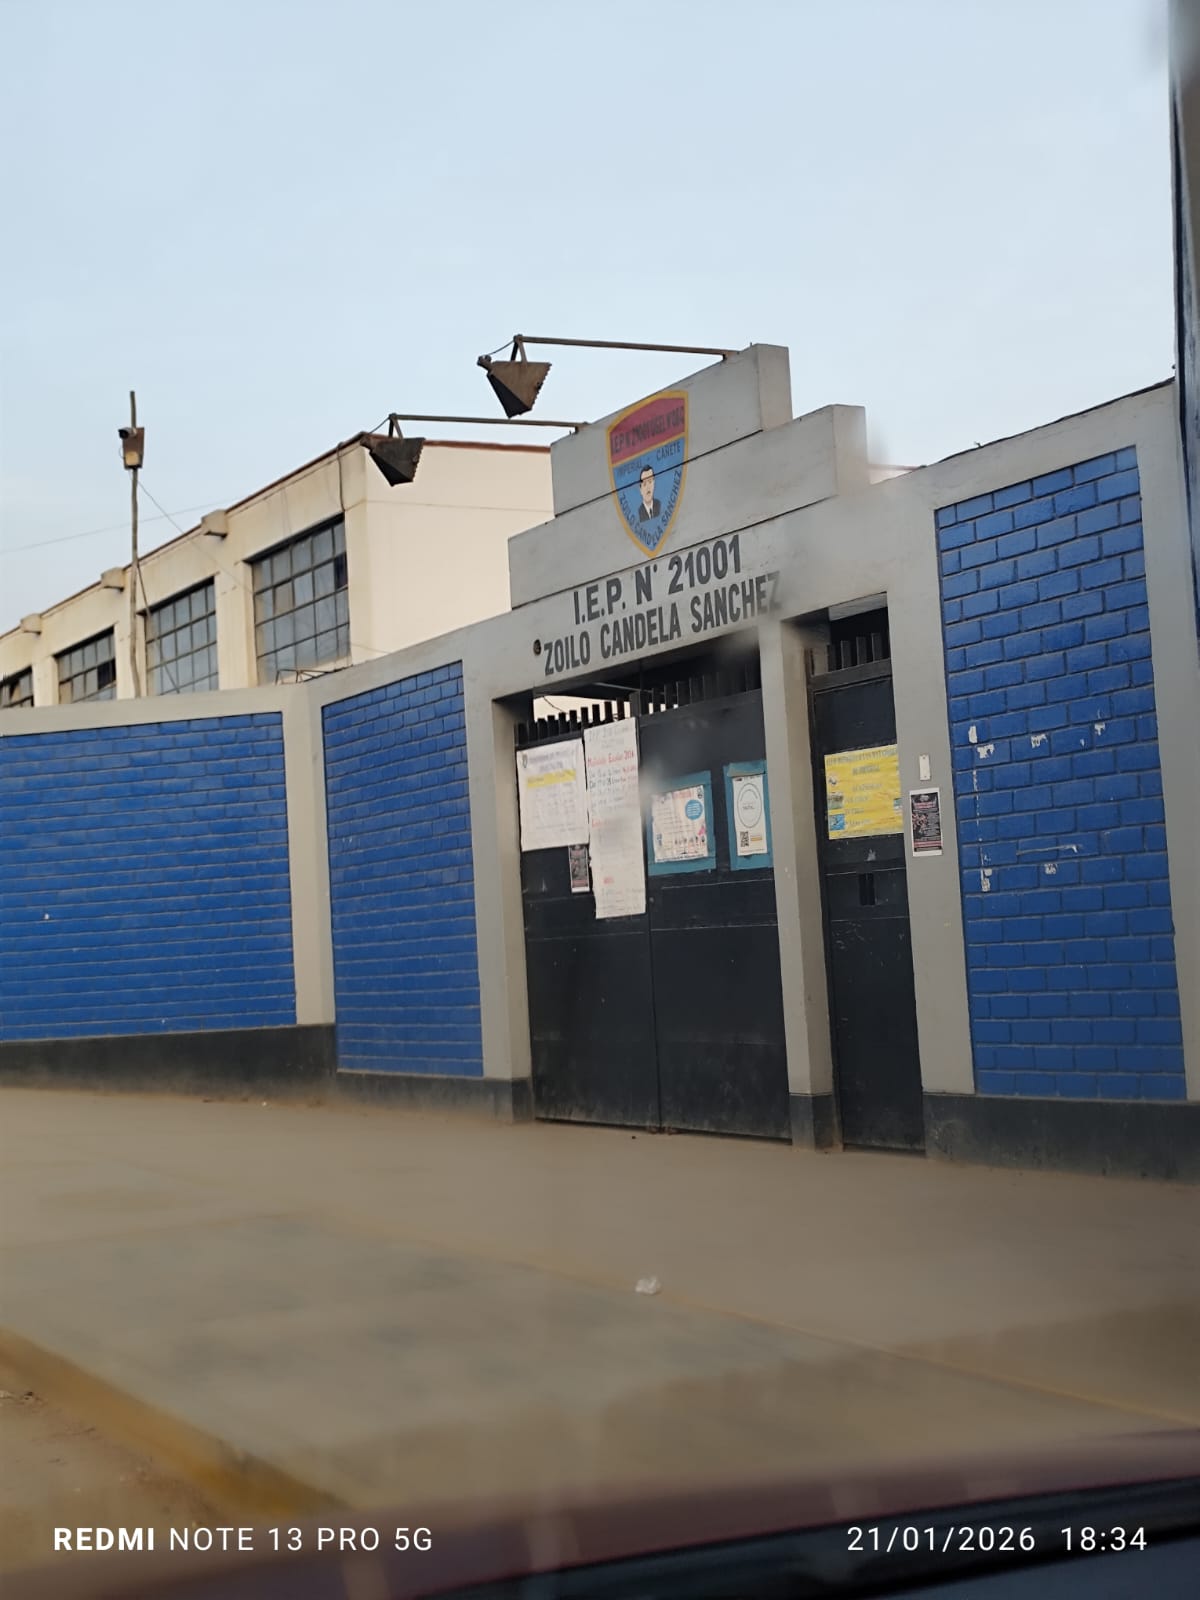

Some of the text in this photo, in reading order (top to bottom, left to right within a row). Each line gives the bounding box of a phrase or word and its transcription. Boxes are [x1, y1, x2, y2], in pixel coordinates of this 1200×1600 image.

[543, 570, 782, 677] ZOILO CANDELA SANCHEZ
[573, 577, 626, 625] I.E.P.
[668, 534, 741, 596] 21001
